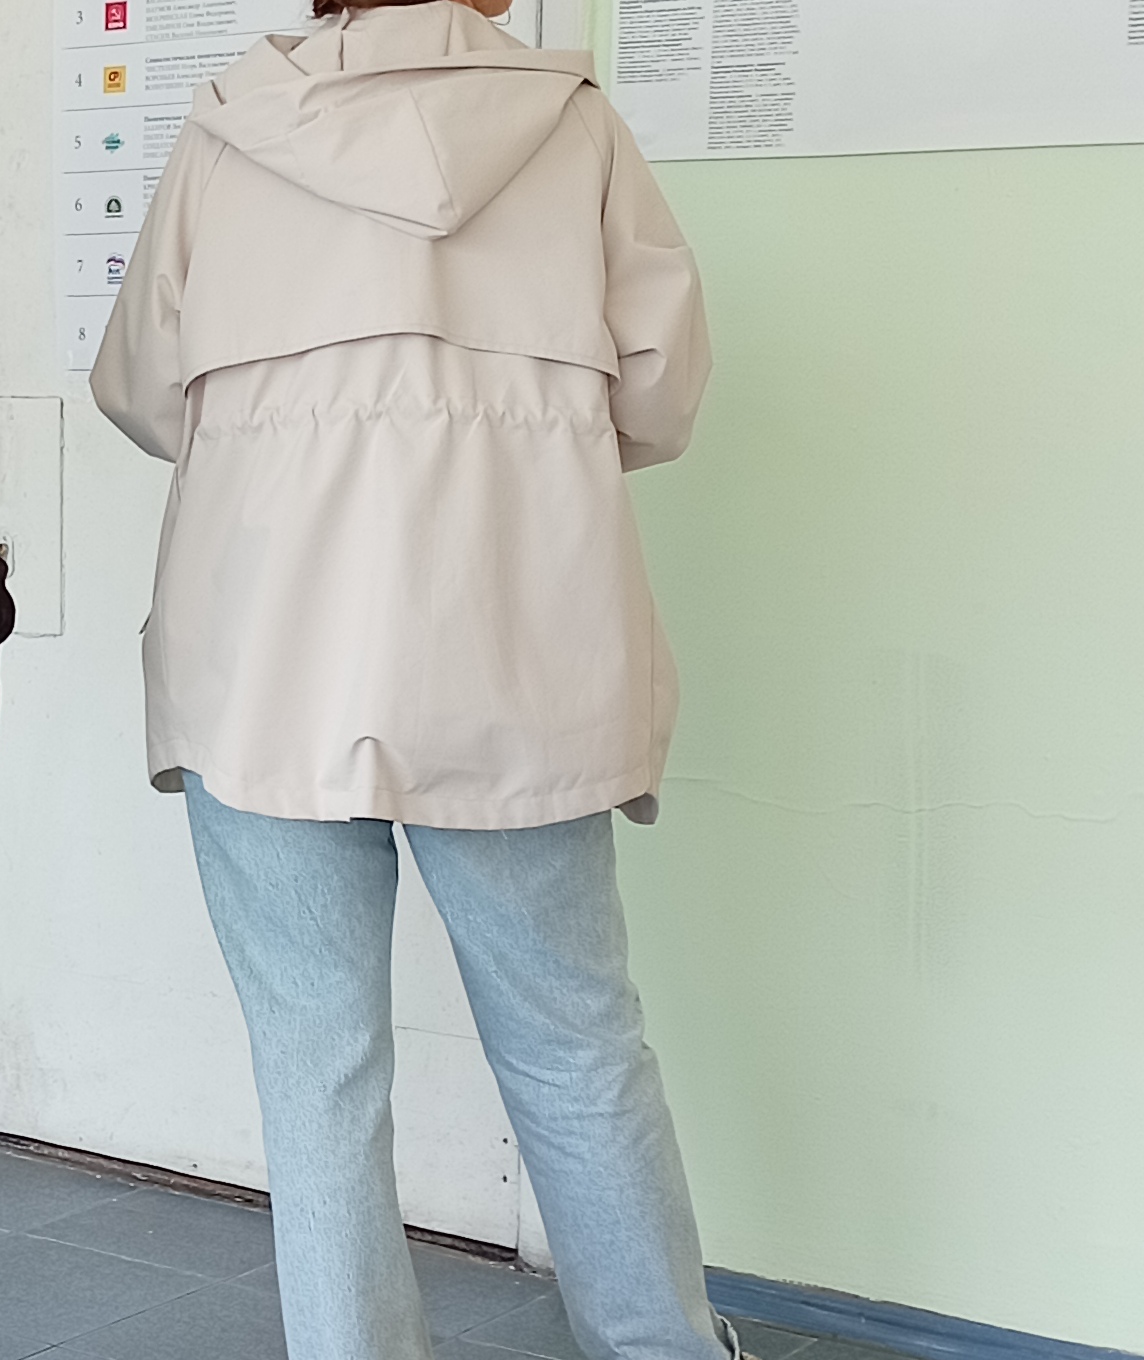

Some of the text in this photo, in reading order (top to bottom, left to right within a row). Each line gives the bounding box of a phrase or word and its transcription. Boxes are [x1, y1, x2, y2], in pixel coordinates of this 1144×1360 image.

[76, 10, 83, 25] 3
[75, 74, 82, 87] 4
[74, 136, 81, 149] 5
[74, 198, 82, 211] 6
[77, 260, 83, 273] 7
[78, 327, 86, 340] 8
